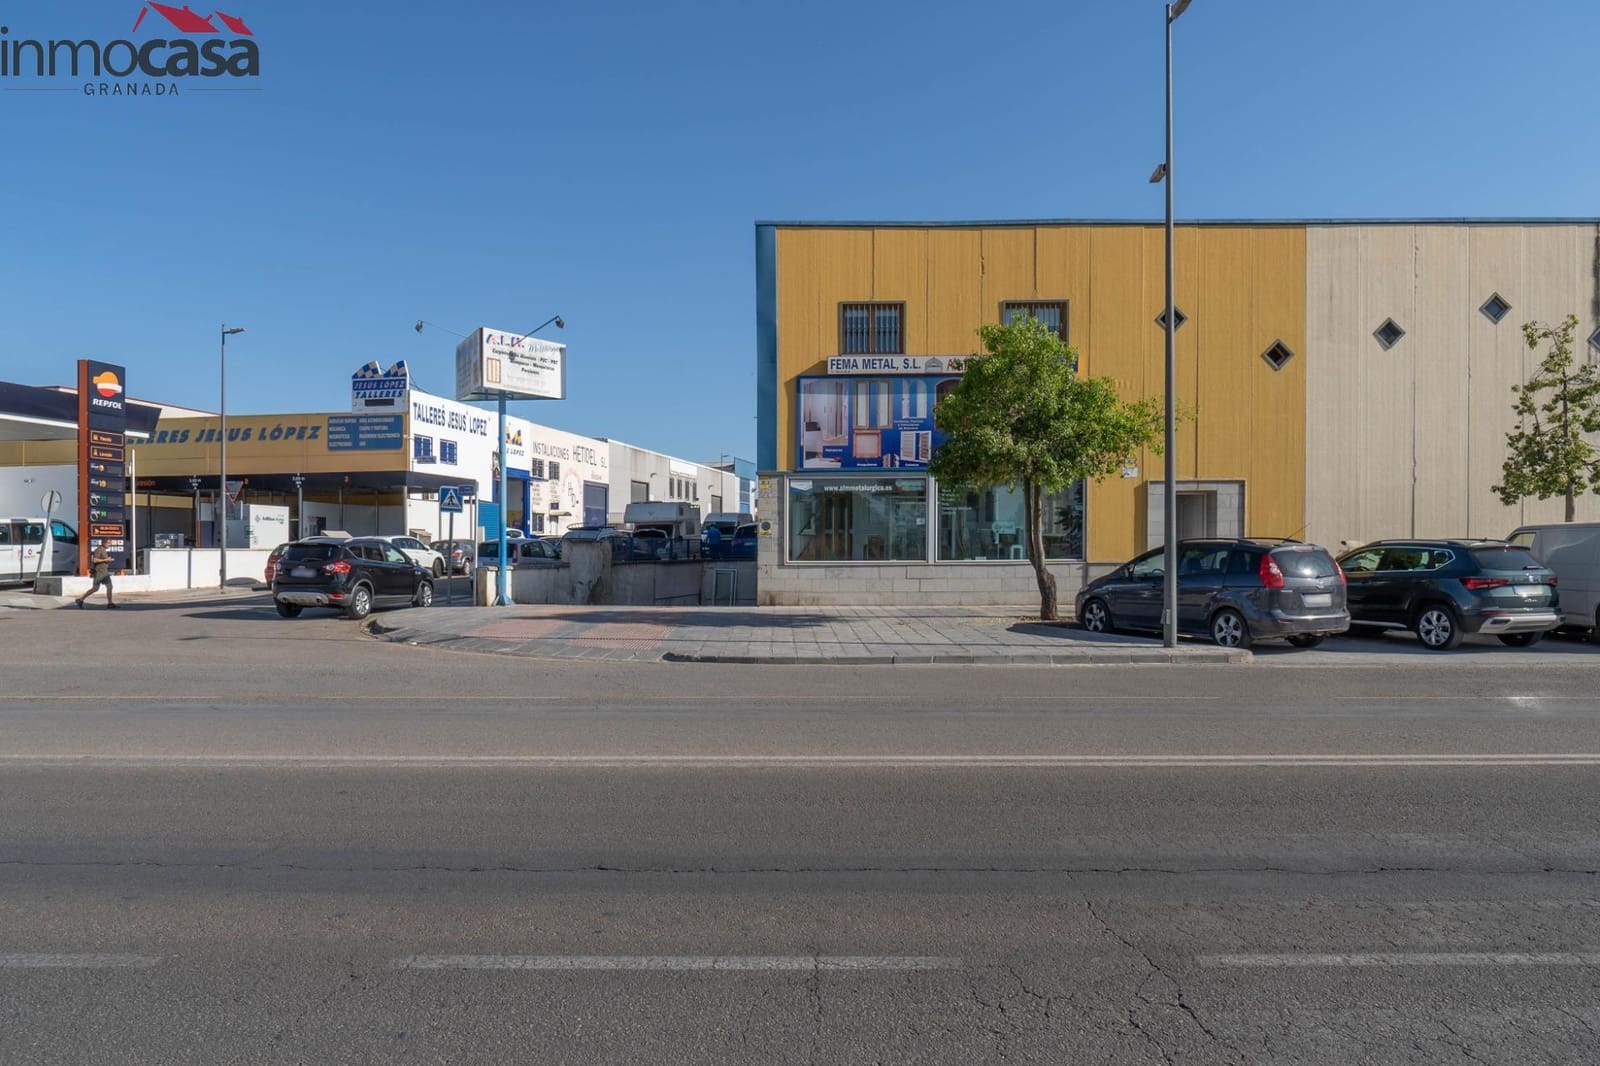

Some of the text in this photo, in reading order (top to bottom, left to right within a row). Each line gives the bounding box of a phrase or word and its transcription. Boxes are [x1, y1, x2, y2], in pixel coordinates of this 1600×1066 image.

[830, 358, 921, 371] FEMA METAL, S.L.
[355, 390, 403, 399] TALLERES
[92, 398, 123, 410] REPSOL
[413, 402, 446, 427] TALLERES
[195, 427, 252, 443] JESUS
[259, 424, 323, 441] LÓPEZ
